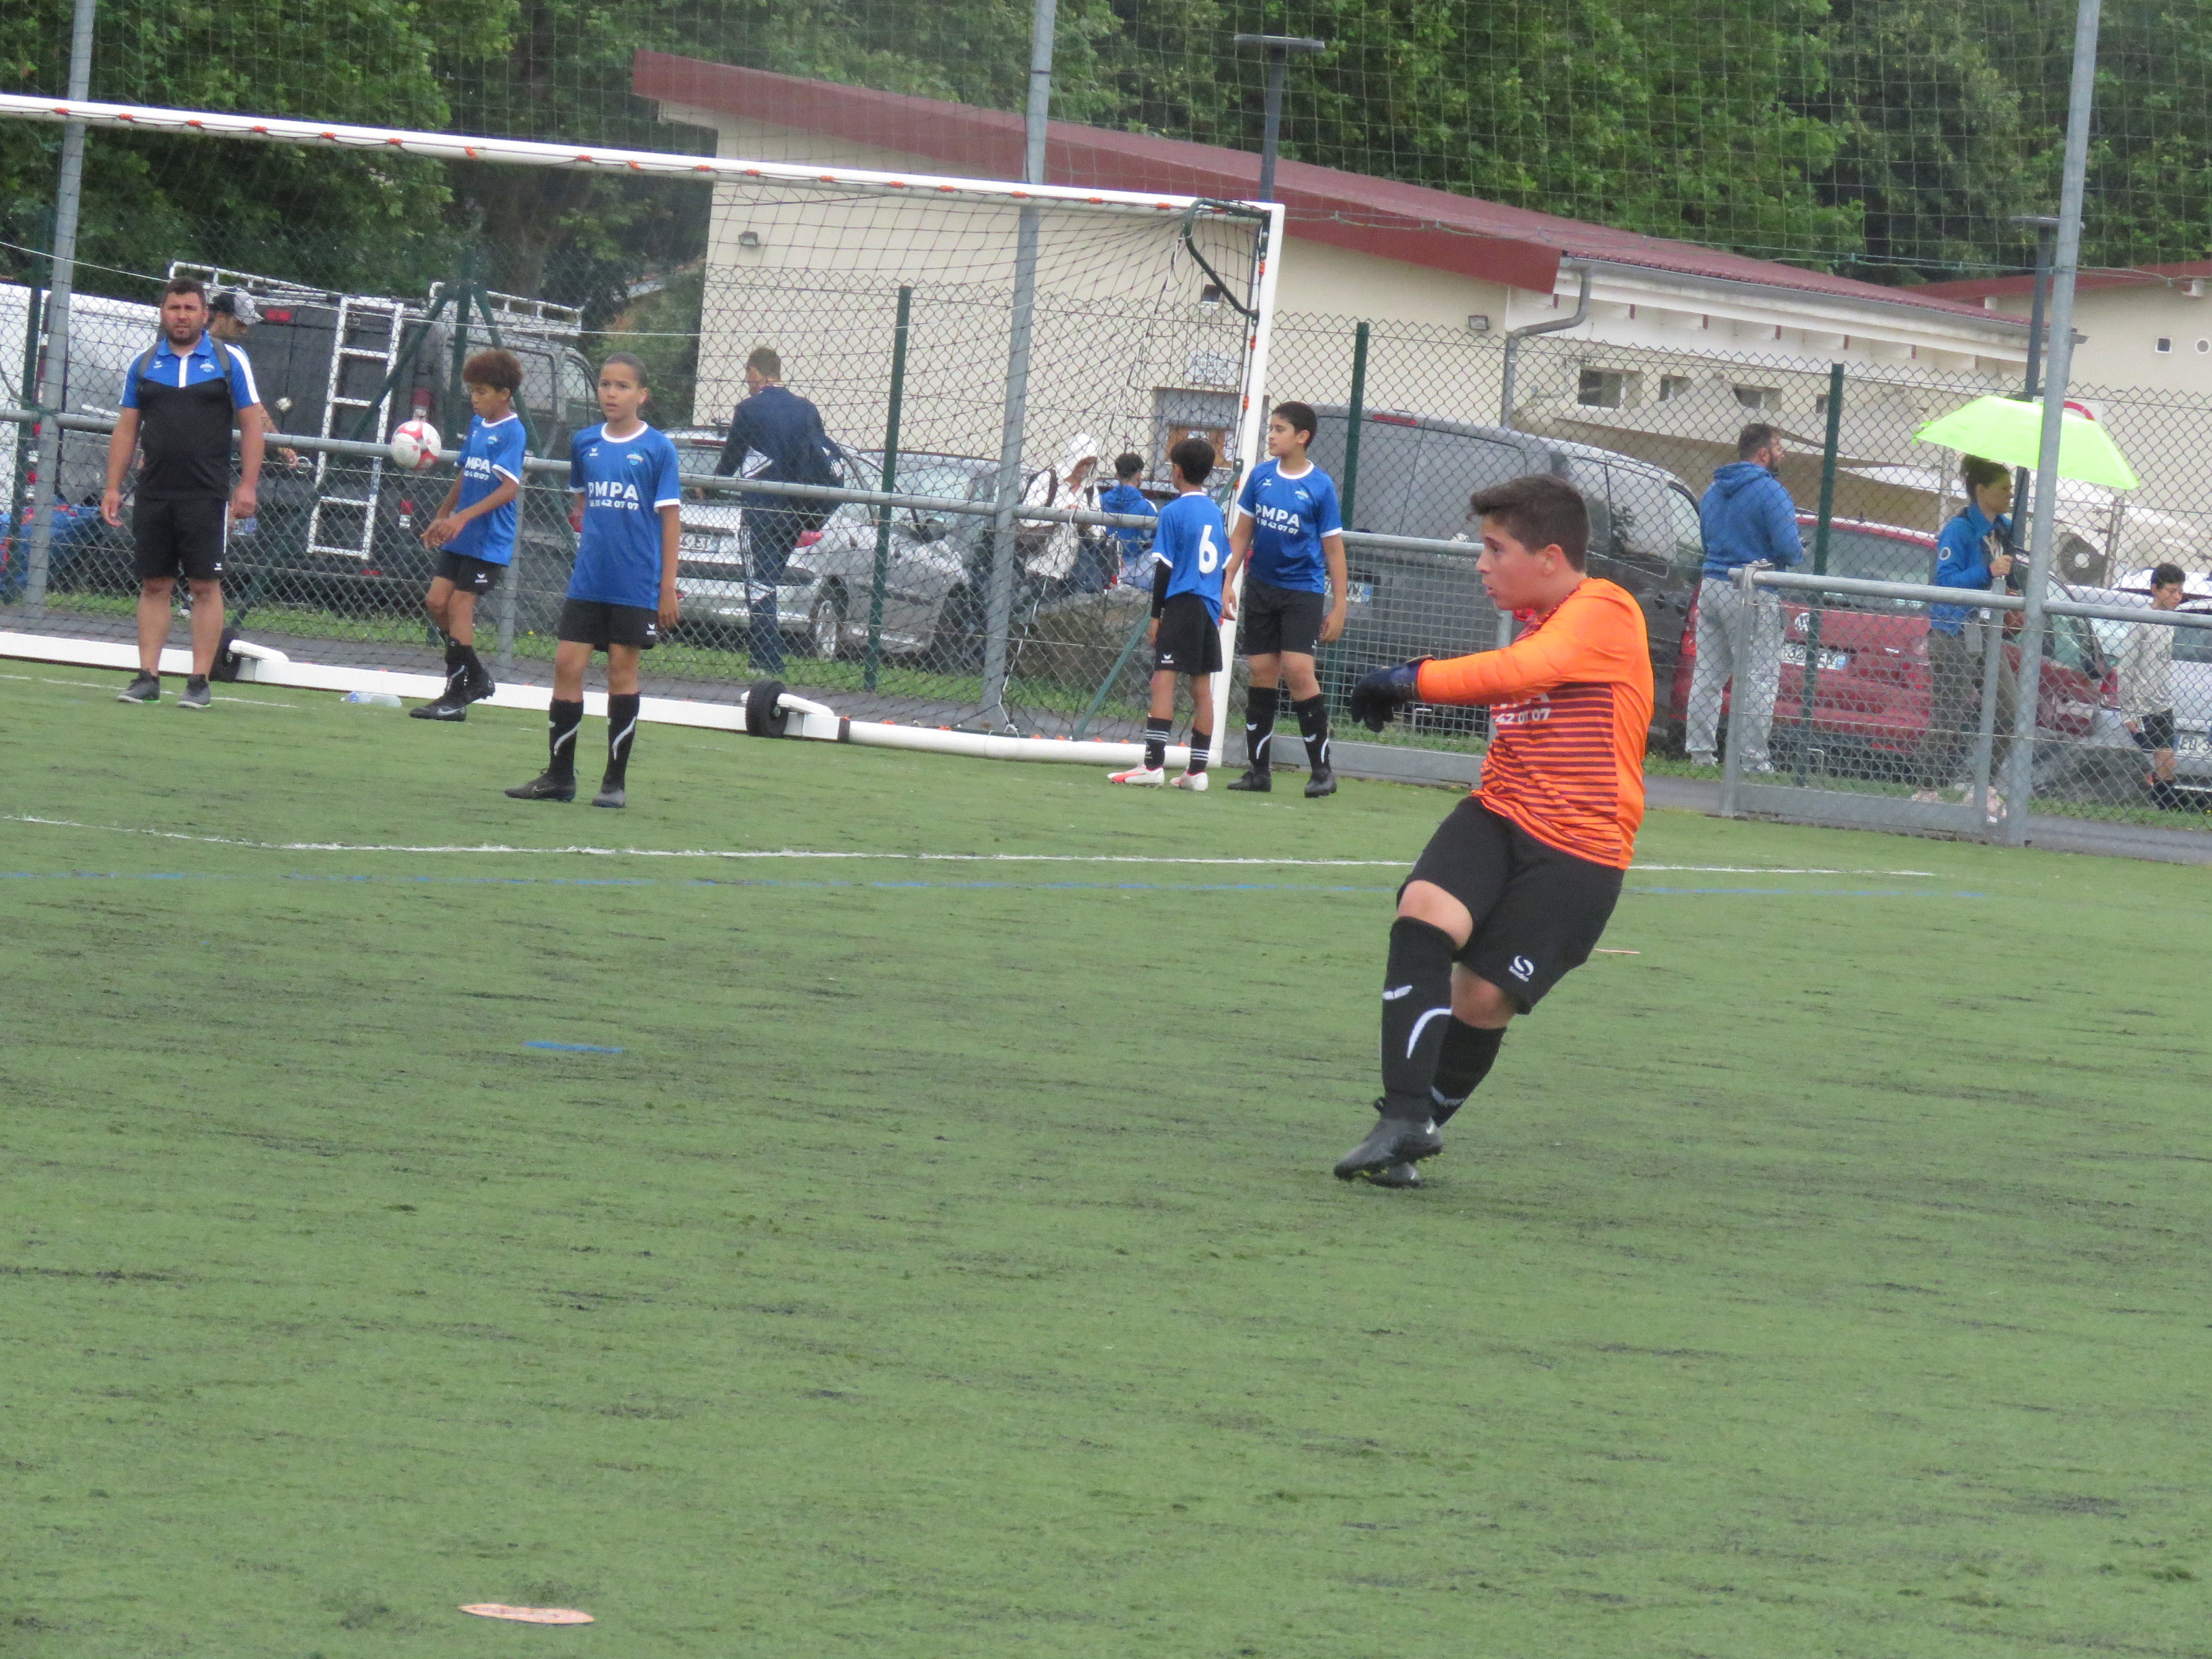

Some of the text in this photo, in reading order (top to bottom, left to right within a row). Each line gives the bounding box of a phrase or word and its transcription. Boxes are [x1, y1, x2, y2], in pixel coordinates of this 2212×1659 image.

[588, 481, 639, 501] PMPA
[614, 500, 626, 508] 07
[627, 501, 640, 510] 07
[1255, 503, 1300, 527] PMPA
[1277, 524, 1288, 532] 07
[1198, 524, 1218, 574] 6
[1532, 708, 1551, 721] 07
